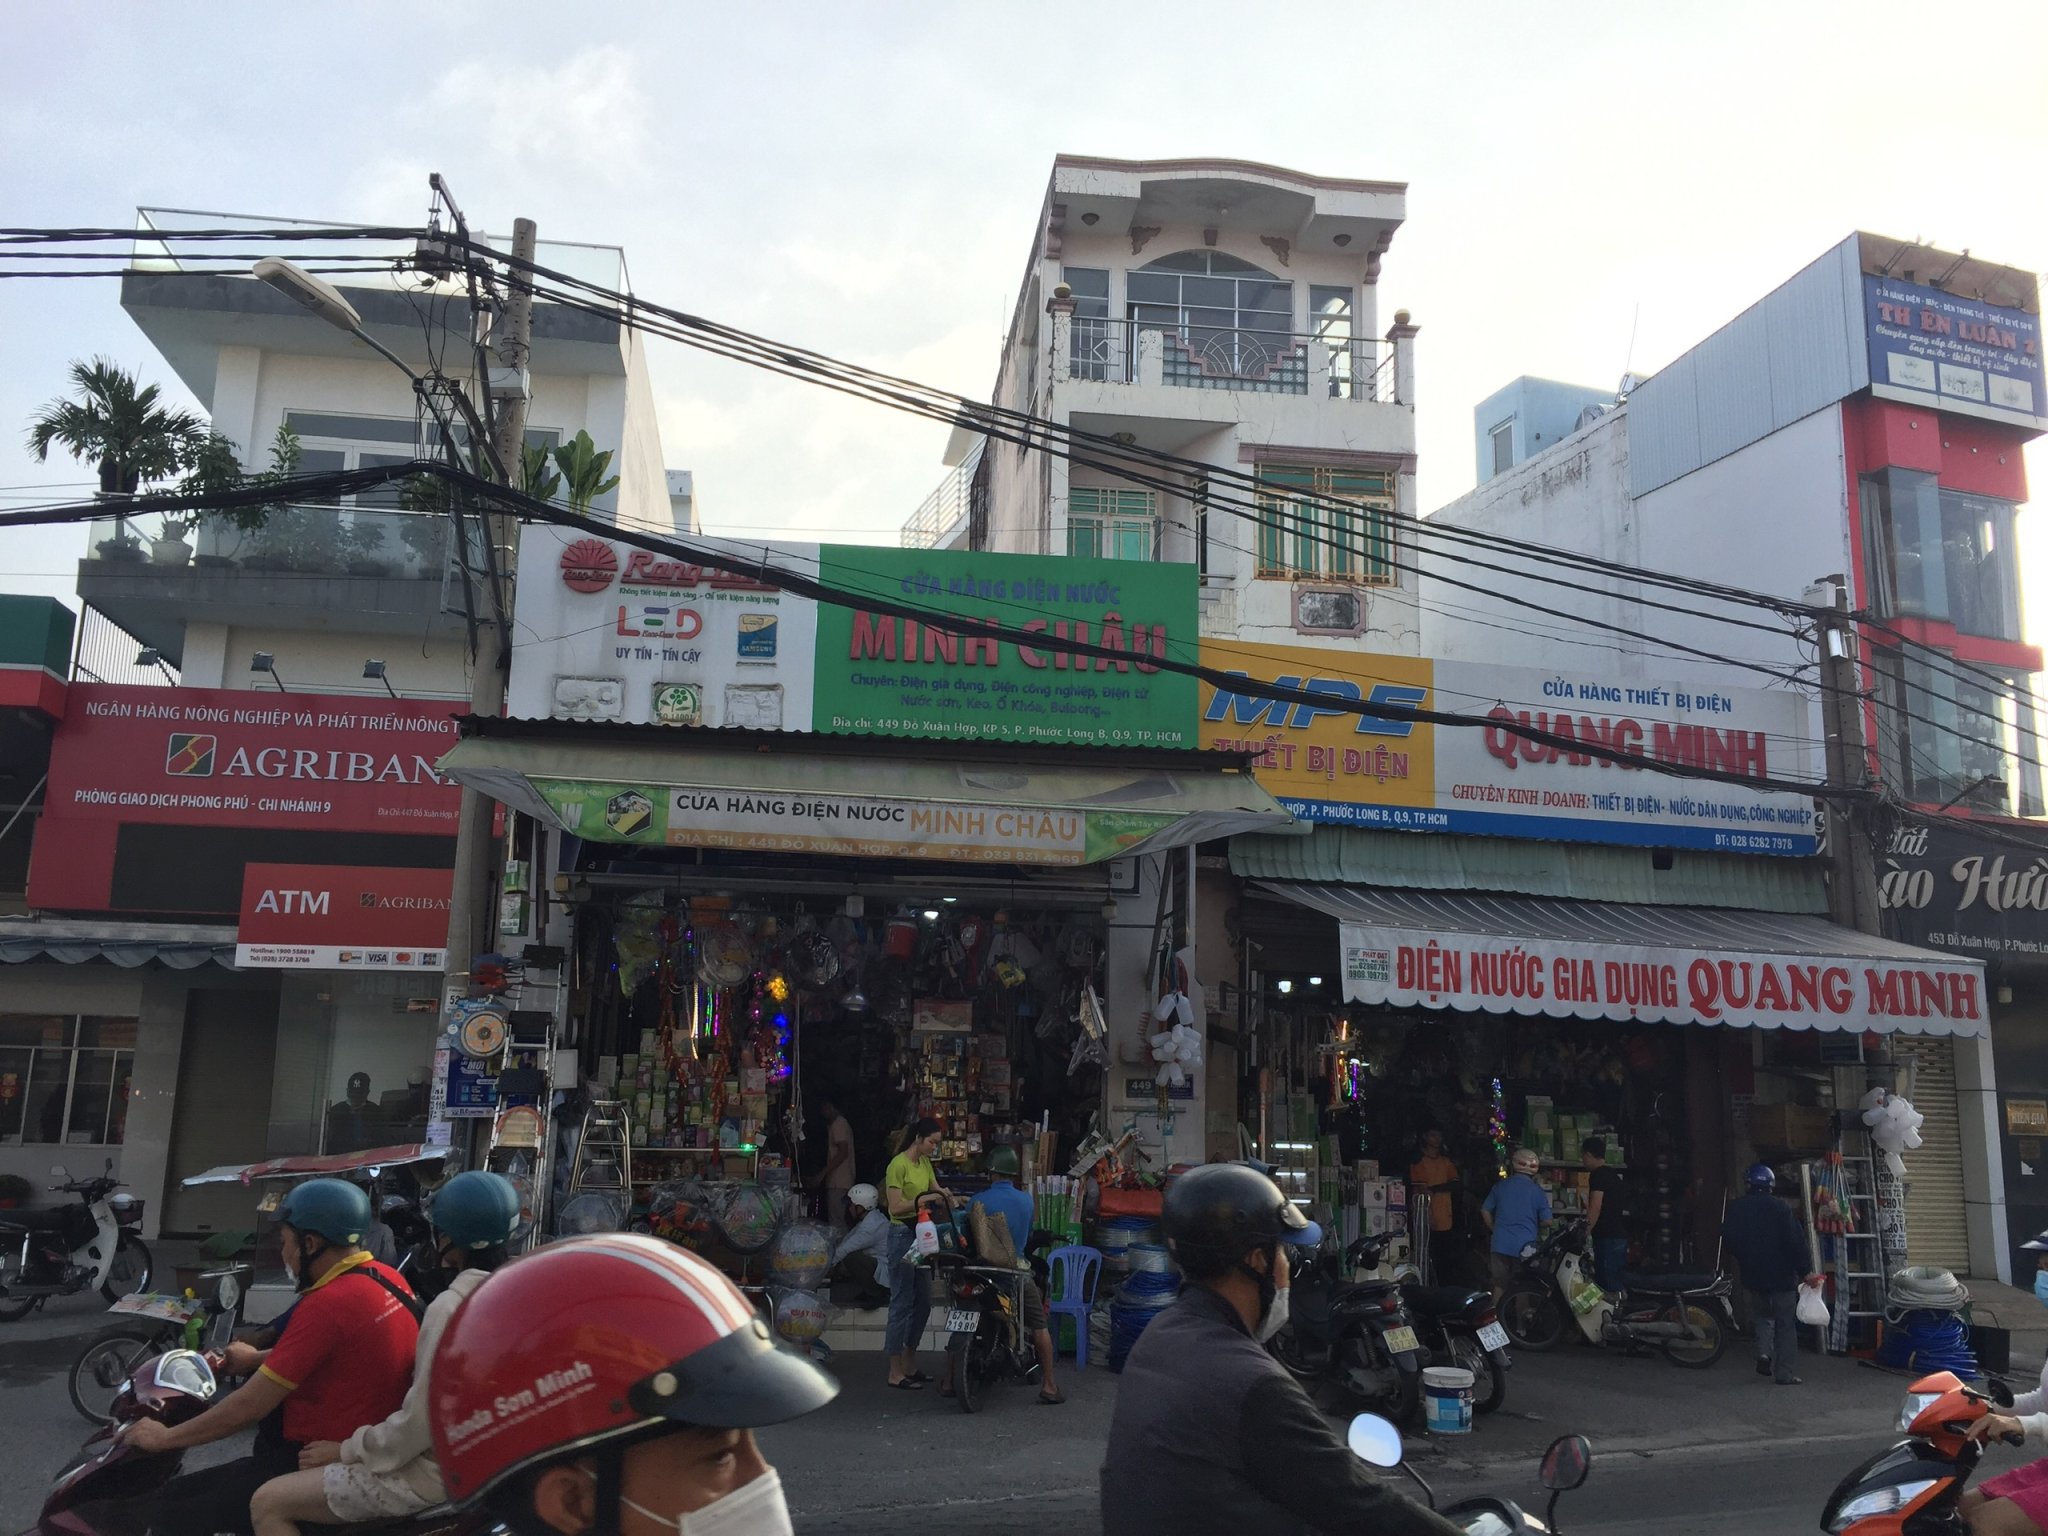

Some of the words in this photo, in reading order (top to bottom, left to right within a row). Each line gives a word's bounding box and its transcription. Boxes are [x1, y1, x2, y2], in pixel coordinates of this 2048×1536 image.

[1957, 320, 2017, 350] LUÂN
[901, 570, 942, 596] CỬA
[949, 572, 1007, 600] HÀNG
[1012, 577, 1061, 606] ĐIỆN
[1066, 581, 1121, 606] NƯỚC
[616, 605, 703, 640] LED
[616, 647, 631, 659] UY
[634, 645, 652, 661] TÍN
[662, 646, 679, 662] TÍN
[681, 648, 702, 665] CẬY
[850, 609, 999, 667] MINH
[1019, 611, 1166, 674] CHÂU
[901, 675, 928, 691] Điện
[931, 678, 949, 692] gia
[991, 679, 1018, 694] Điện
[1543, 676, 1574, 698] CỬA
[1579, 682, 1621, 703] HÀNG
[1625, 685, 1670, 707] THIẾT
[1675, 693, 1691, 713] BỊ
[1696, 693, 1732, 714] ĐIỆN
[86, 701, 132, 717] NGÂN
[136, 702, 181, 720] HÀNG
[184, 705, 230, 723] NÔNG
[233, 708, 292, 728] NGHIỆP
[294, 710, 314, 727] VÀ
[318, 711, 358, 730] PHÁT
[361, 711, 404, 732] TRIỂN
[406, 716, 449, 734] NÔNG
[1204, 670, 1428, 737] MPE
[833, 717, 850, 730] Địa
[877, 718, 899, 730] 449
[923, 720, 950, 733] Xuân
[954, 722, 979, 735] Hợp,
[983, 724, 998, 734] KP
[1015, 726, 1025, 736] P.
[1029, 725, 1063, 737] Phước
[1067, 728, 1094, 741] Long
[1137, 731, 1152, 741] TP.
[1156, 731, 1182, 743] HCM
[1484, 706, 1643, 769] QUANG
[1654, 722, 1767, 780] MINH
[221, 746, 460, 786] AGRIBAN
[1307, 744, 1336, 781] BỊ
[1343, 743, 1409, 783] ĐIỆN
[75, 788, 117, 805] PHÒNG
[119, 792, 148, 807] GIAO
[150, 793, 179, 809] DỊCH
[180, 795, 222, 810] PHONG
[224, 793, 249, 810] PHÚ
[258, 798, 278, 811] CHI
[280, 796, 323, 813] NHÁNH
[323, 801, 331, 813] 9
[677, 791, 719, 811] CỬA
[727, 795, 785, 816] HÀNG
[792, 800, 839, 821] ĐIỆN
[847, 804, 905, 822] NƯỚC
[910, 808, 985, 836] MINH
[995, 812, 1078, 842] CHÂU
[1311, 806, 1321, 817] P.
[1322, 801, 1354, 819] PHƯỚC
[1356, 807, 1381, 822] LONG
[1382, 809, 1392, 824] B,
[1394, 810, 1412, 826] Q.9,
[1452, 784, 1505, 803] CHUYÊN
[1507, 789, 1539, 806] KINH
[1542, 791, 1591, 809] DOANH:
[1592, 792, 1621, 812] THIẾT
[1624, 796, 1635, 816] BỊ
[1670, 795, 1696, 816] NƯỚC
[1698, 799, 1718, 818] DÂN
[1778, 808, 1812, 828] NGHIỆP
[917, 846, 928, 857] 9
[1716, 834, 1730, 846] ĐT:
[1732, 835, 1748, 847] 028
[1750, 836, 1771, 849] 6282
[1772, 837, 1793, 850] 7978
[254, 889, 330, 915] ATM
[1928, 932, 1945, 945] 453
[1961, 935, 1983, 948] Xuân
[368, 953, 388, 962] VISA
[1396, 939, 1462, 1003] ĐIỆN
[1470, 946, 1545, 999] NƯỚC
[1553, 957, 1598, 1003] GIA
[1605, 961, 1678, 1015] DỤNG
[1687, 958, 1856, 1018] QUANG
[1864, 968, 1983, 1020] MINH
[1131, 1081, 1151, 1090] 449
[535, 1361, 593, 1397] Minh
